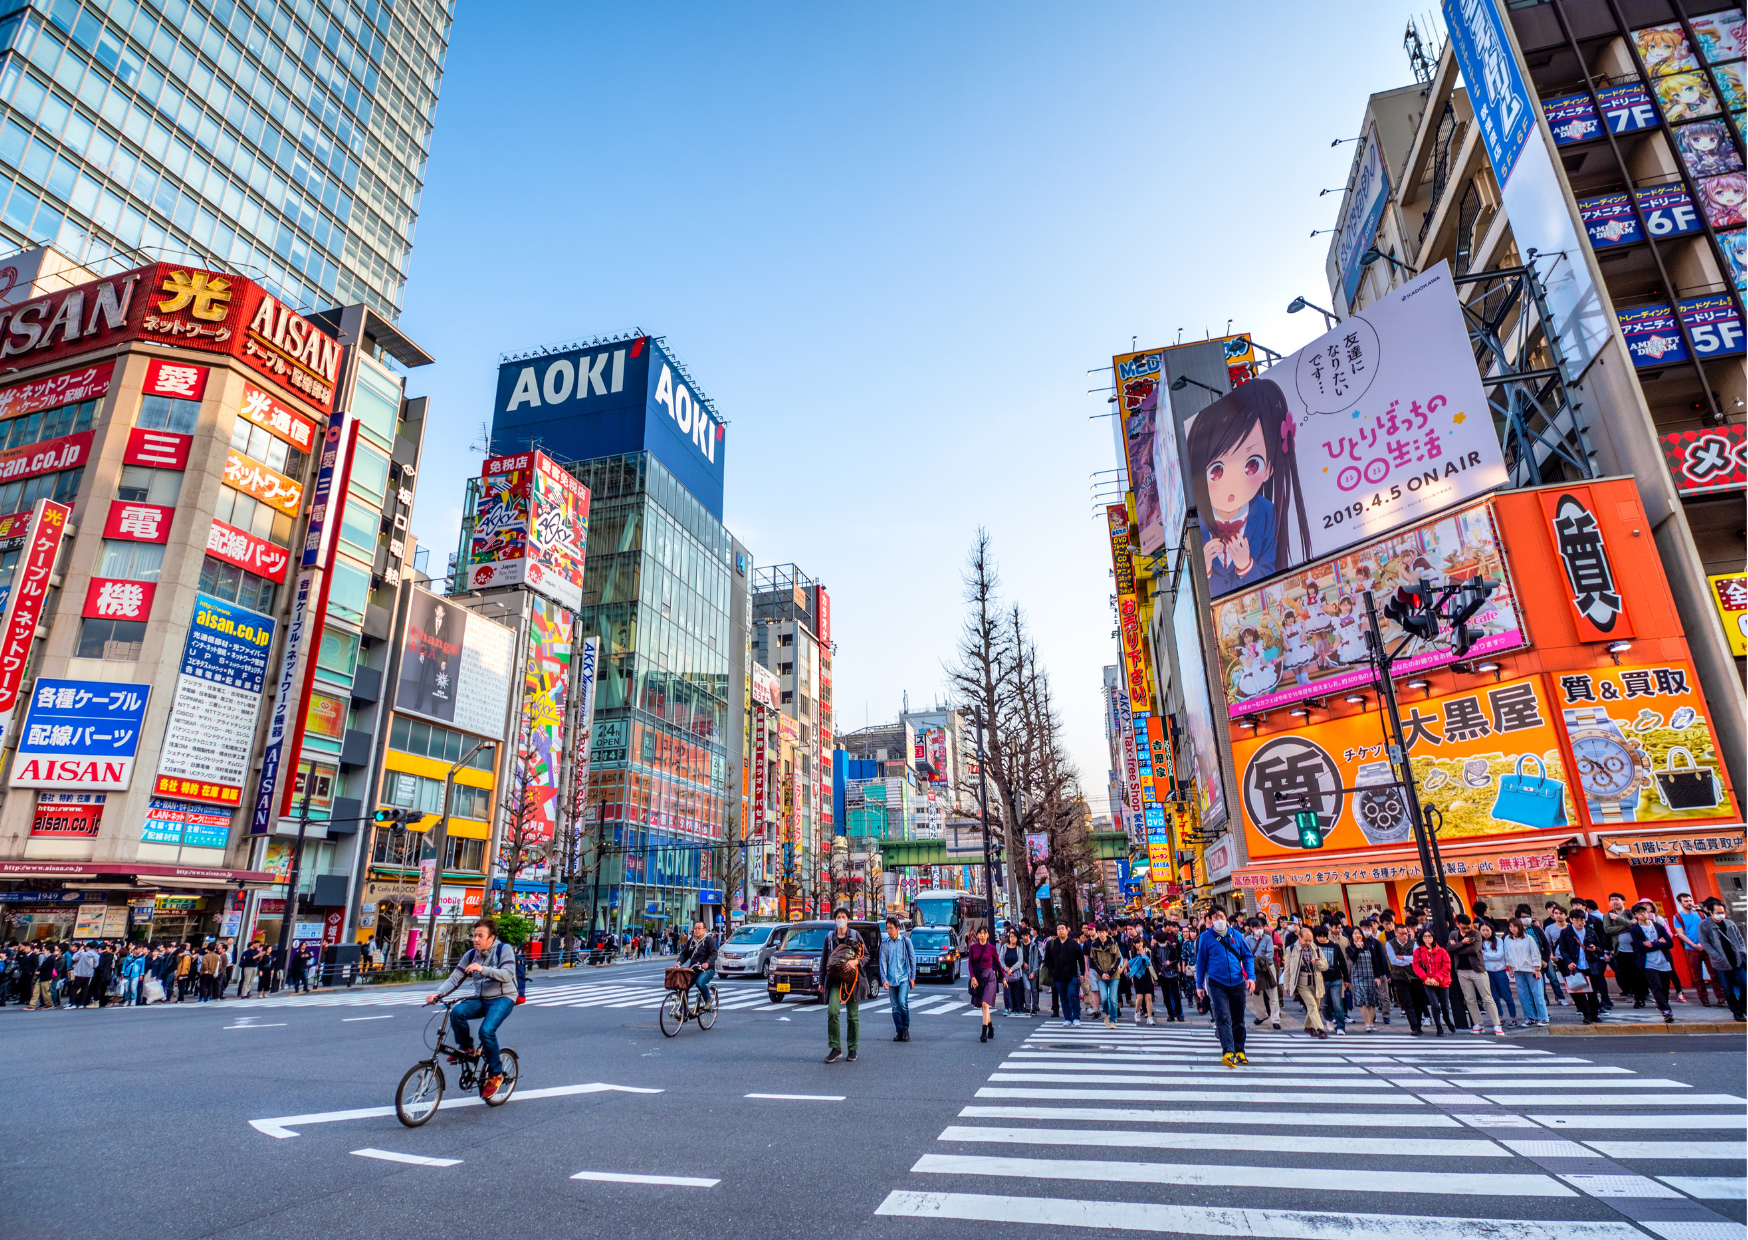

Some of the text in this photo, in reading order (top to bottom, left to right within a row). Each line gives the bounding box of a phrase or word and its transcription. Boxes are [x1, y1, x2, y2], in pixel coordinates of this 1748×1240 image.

[1543, 87, 1641, 111] トレーディング カードゲーム
[1545, 105, 1594, 121] アメニティ
[1607, 104, 1654, 133] 7F
[1578, 186, 1681, 210] トレーディング カードゲーム
[1580, 204, 1631, 220] アメニティ
[1648, 205, 1696, 235] 6F
[158, 270, 231, 321] 光
[1407, 276, 1441, 298] KADOKAWA
[1619, 298, 1727, 322] トレーディング カードゲーム
[1621, 318, 1677, 334] アメニティ
[143, 316, 231, 342] ネットワーク
[250, 293, 341, 383] AISAN
[1690, 320, 1743, 353] 5F
[1344, 332, 1365, 374] 友達に
[154, 364, 198, 396] 愛
[506, 350, 625, 412] AOKI
[1327, 345, 1348, 396] なりたい
[241, 391, 310, 446] 光通信
[655, 363, 715, 464] AOKI
[1322, 395, 1447, 461] ひとりぼっちの
[137, 434, 180, 463] 三
[489, 456, 529, 474] 免税店
[224, 455, 301, 508] ネットワーク
[542, 458, 586, 501] 愛客免税店
[1323, 451, 1481, 529] 2019.4.5 ON AIR
[306, 450, 336, 551] 愛三電機
[119, 506, 162, 539] 電
[384, 486, 413, 587] 坂口電熱
[206, 524, 286, 573] 配線パーツ
[97, 582, 143, 617] 機
[197, 610, 269, 646] aisan.co.jp
[1473, 611, 1500, 624] cafe
[408, 640, 437, 661] AGA
[410, 626, 462, 656] Change!
[584, 642, 595, 684] AKKY
[37, 687, 142, 711] 各種ケーブル
[1402, 682, 1545, 754] 大黒屋
[27, 724, 133, 747] 配線パーツ
[17, 760, 125, 783] AISAN
[1151, 740, 1167, 778] 吉野家
[256, 749, 277, 825] AISAN
[1130, 783, 1141, 812] Shop
[1253, 748, 1336, 837] 質
[1233, 875, 1269, 887] 高価買取
[1498, 854, 1557, 870] 無料査定
